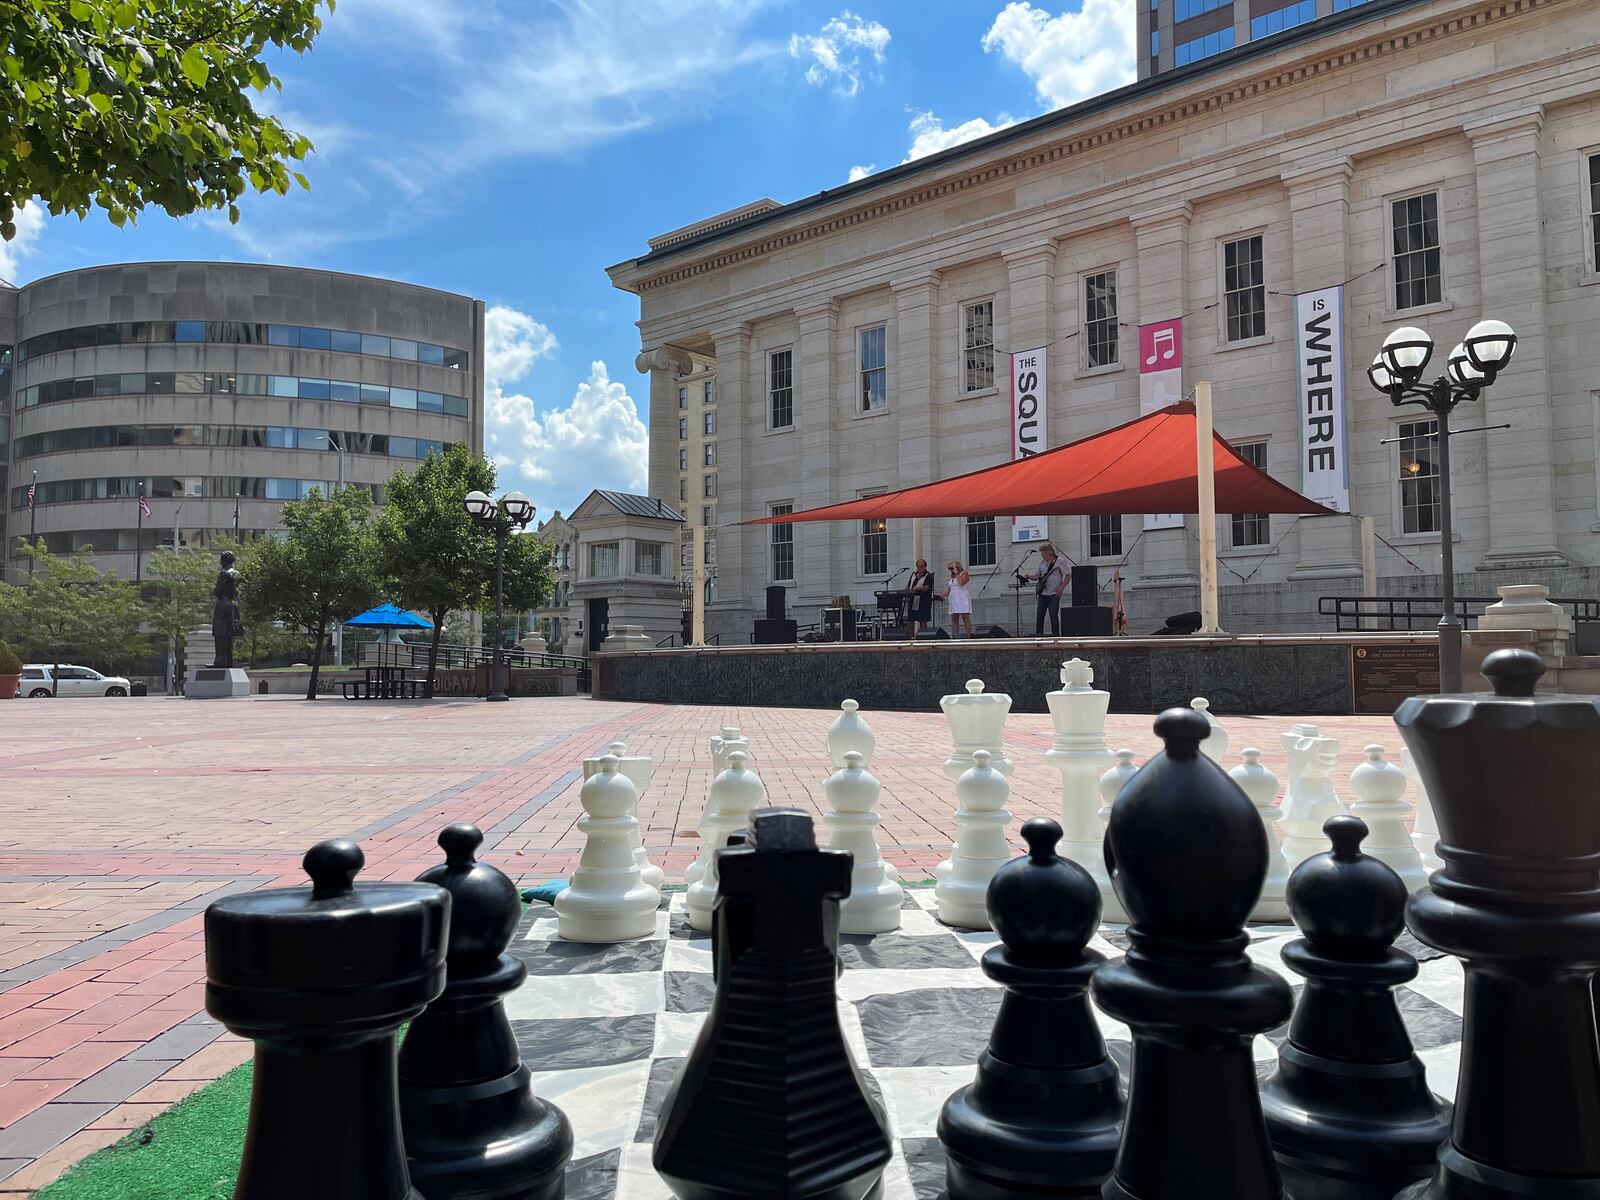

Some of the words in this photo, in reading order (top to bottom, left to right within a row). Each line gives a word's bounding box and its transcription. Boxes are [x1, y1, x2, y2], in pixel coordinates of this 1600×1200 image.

[1312, 299, 1325, 311] IS
[1019, 357, 1037, 369] THE
[1305, 312, 1335, 472] WHERE
